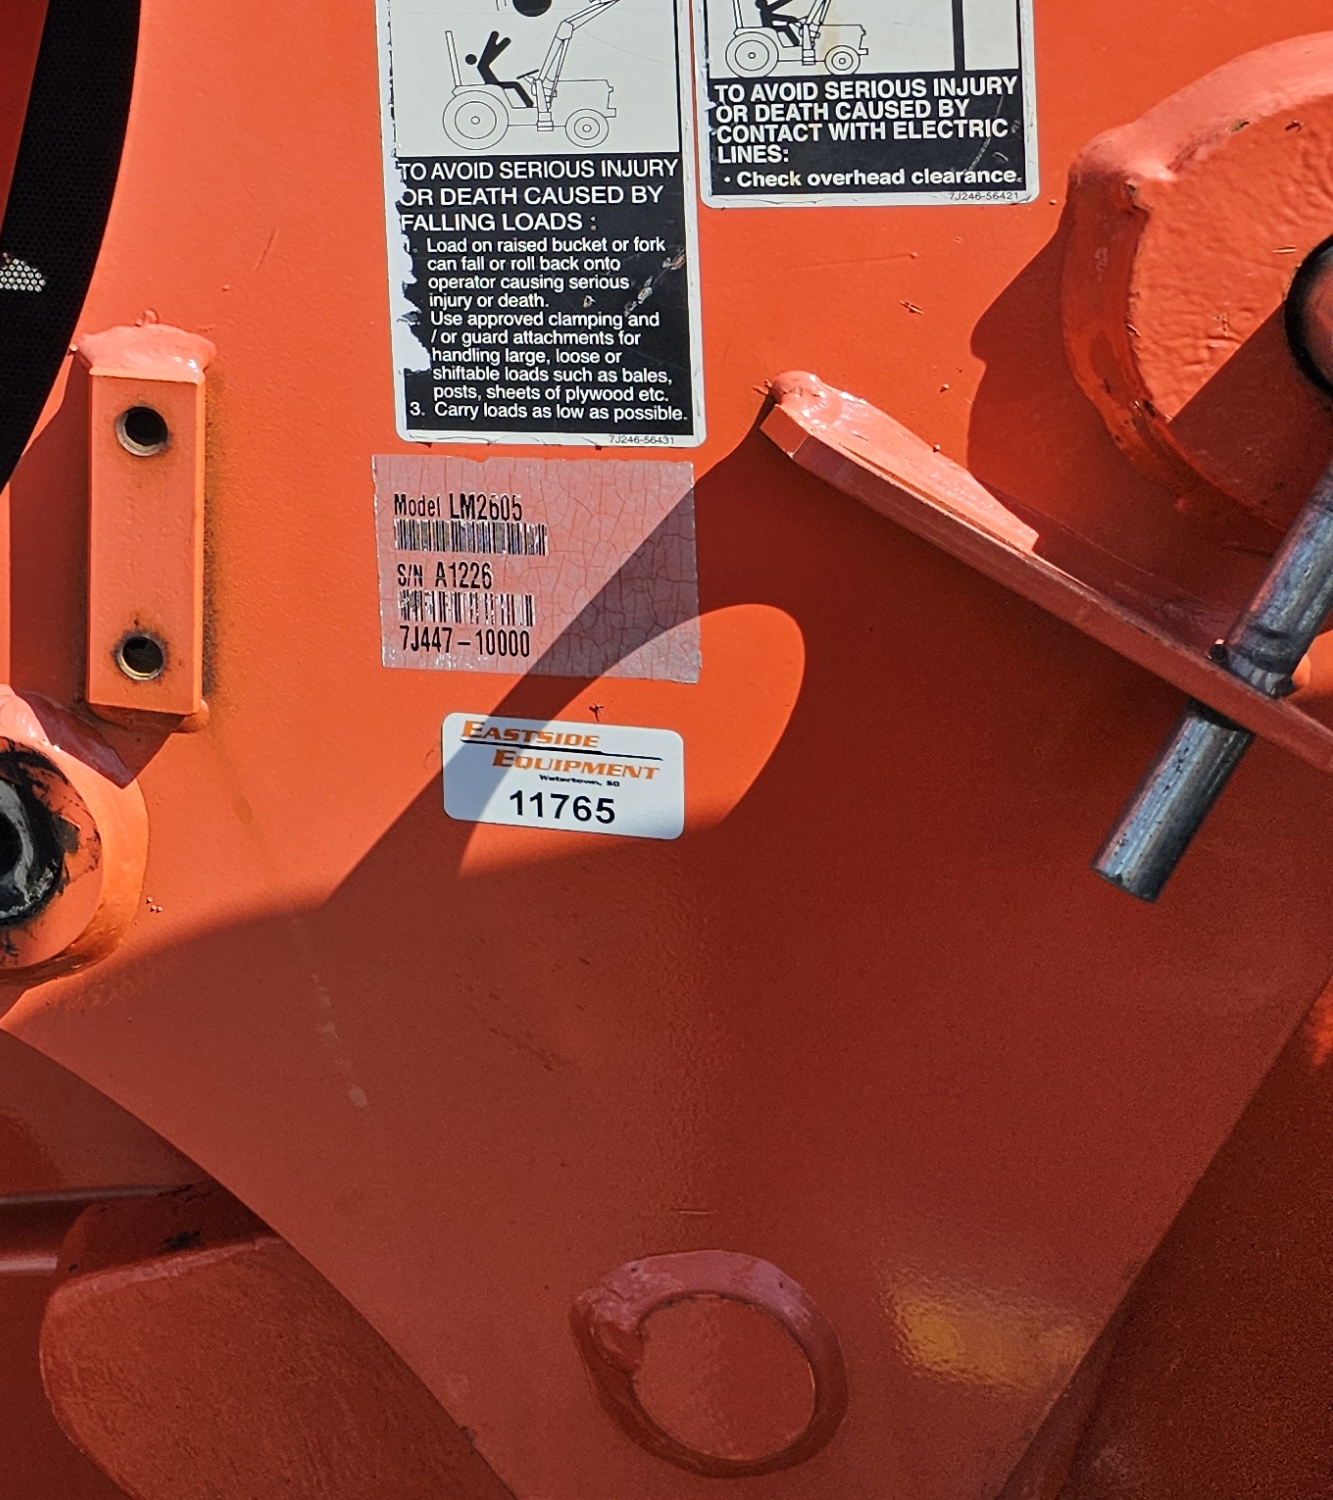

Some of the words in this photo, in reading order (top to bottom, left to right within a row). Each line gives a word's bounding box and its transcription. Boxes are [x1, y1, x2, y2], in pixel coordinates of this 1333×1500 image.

[715, 84, 744, 102] TO
[751, 82, 818, 101] AVOID
[825, 79, 926, 99] SERIOUS
[934, 76, 1017, 96] INJURY
[716, 102, 747, 123] OR
[755, 103, 828, 122] DEATH
[836, 100, 931, 120] CAUSED
[939, 99, 969, 117] BY
[716, 124, 822, 143] CONTACT
[828, 122, 885, 140] WITH
[893, 119, 1007, 139] ELECTRIC
[718, 144, 788, 163] LINES:
[398, 162, 426, 180] TO
[431, 162, 493, 179] AVOID
[500, 160, 594, 178] SERIOUS
[602, 159, 678, 177] INJURY
[737, 171, 801, 187] Check
[808, 169, 905, 186] overhead
[912, 168, 1021, 184] clearance.
[400, 188, 433, 207] OR
[441, 188, 517, 205] DEATH
[524, 186, 623, 204] CAUSED
[632, 186, 663, 203] BY
[400, 213, 495, 232] FALLING
[503, 213, 582, 230] LOADS
[410, 402, 425, 415] 3.
[435, 402, 479, 420] Carry
[484, 403, 527, 418] loads
[532, 407, 551, 418] as
[557, 404, 584, 418] low
[589, 408, 609, 419] as
[614, 405, 687, 422] possible.
[395, 494, 440, 517] Model
[449, 493, 522, 521] LM2605
[397, 564, 422, 587] S/N
[435, 562, 491, 589] A1226
[461, 720, 600, 748] EASTSIDE
[492, 749, 660, 780] EQUIPMENT
[510, 790, 615, 824] 11765
